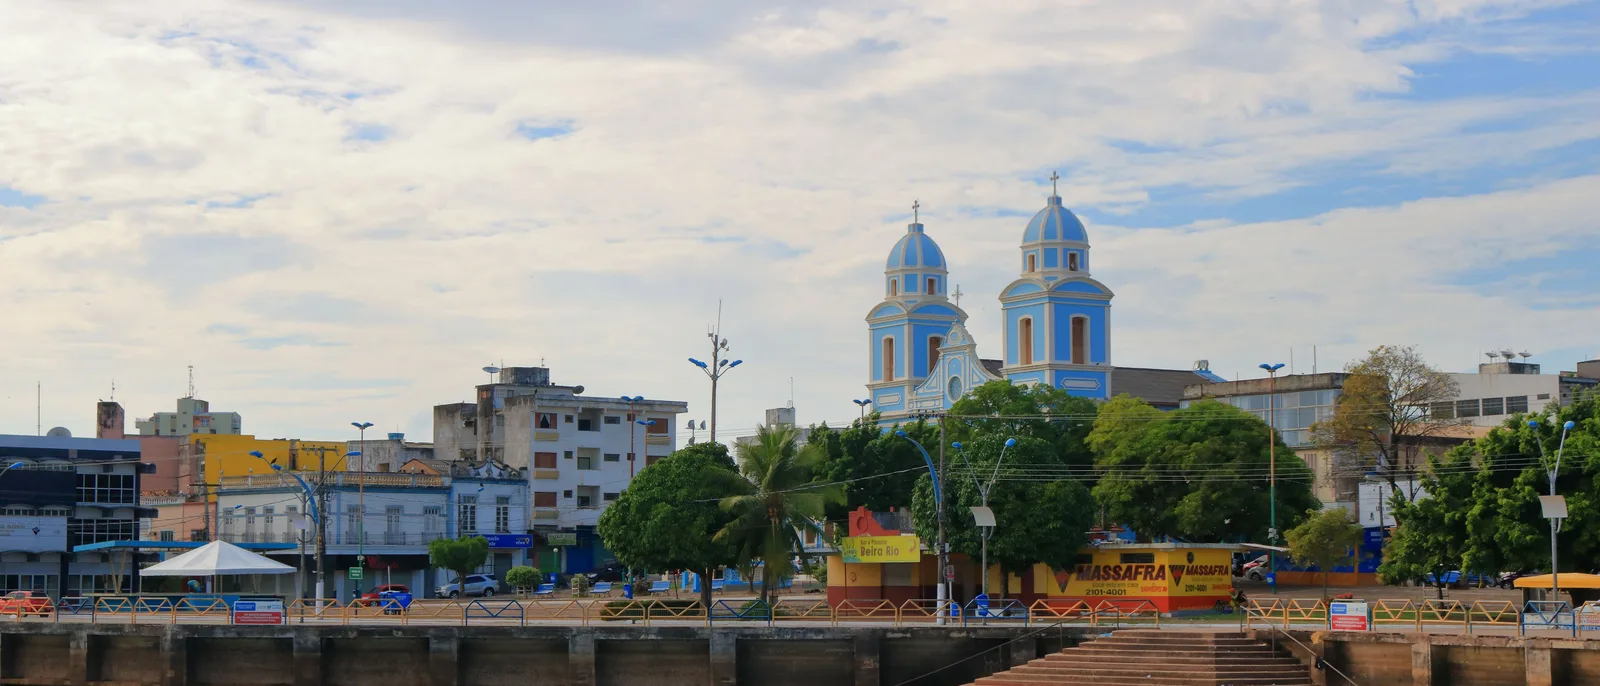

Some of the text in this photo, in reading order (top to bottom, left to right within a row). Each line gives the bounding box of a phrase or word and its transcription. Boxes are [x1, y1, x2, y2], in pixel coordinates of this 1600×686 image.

[861, 546, 882, 556] Beira
[886, 546, 899, 556] Rio
[1076, 564, 1166, 581] MASSAFRA
[1185, 564, 1229, 576] MASSAFRA
